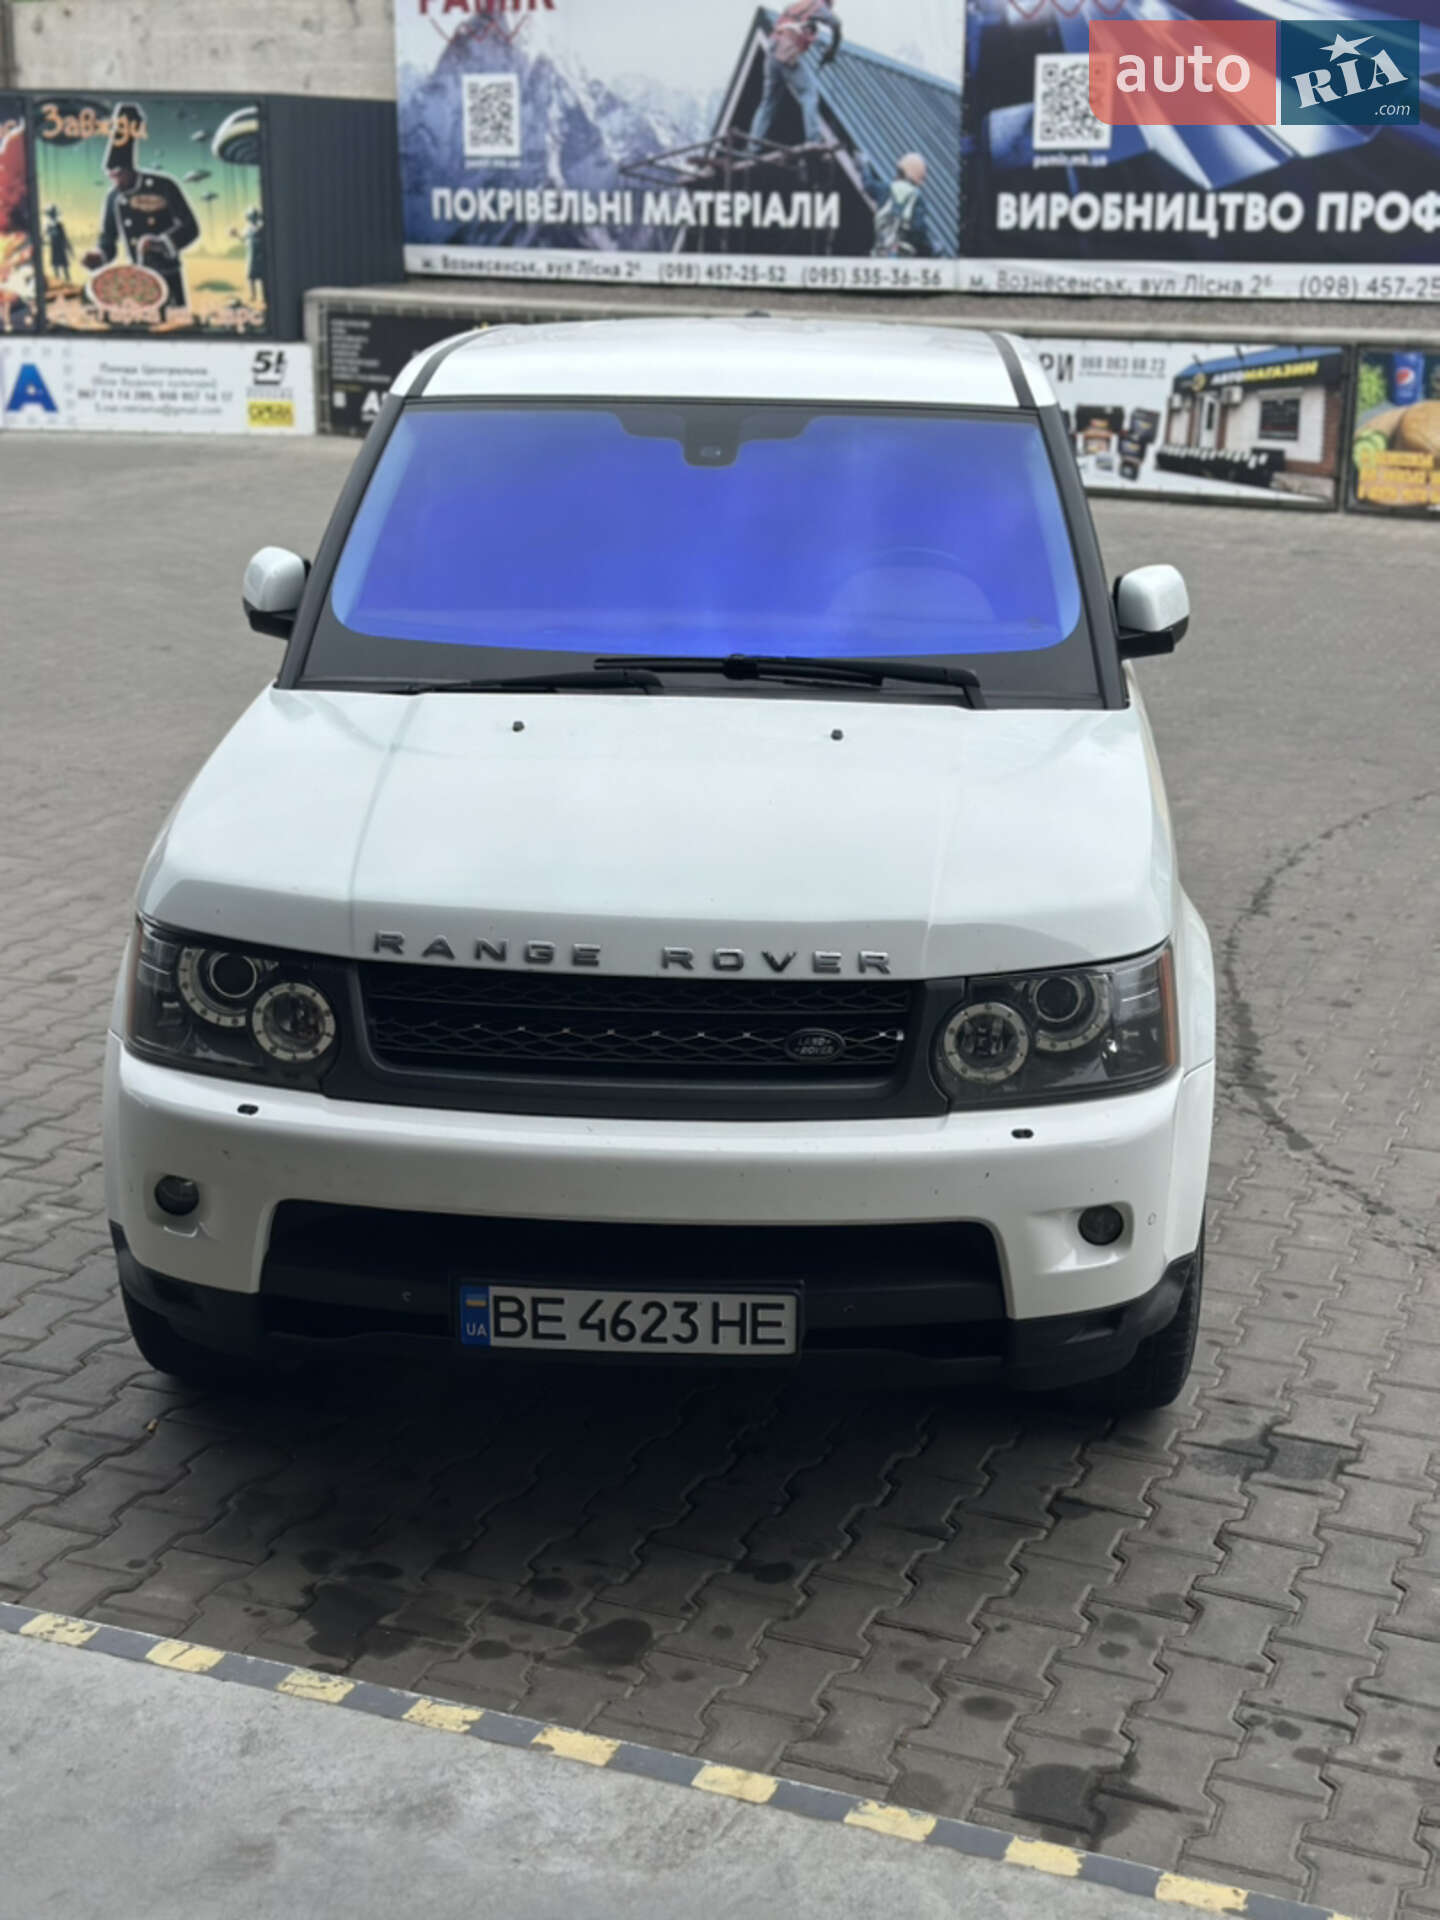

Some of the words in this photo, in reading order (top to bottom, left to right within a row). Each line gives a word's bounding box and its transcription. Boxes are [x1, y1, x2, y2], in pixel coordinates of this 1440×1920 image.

[41, 103, 148, 147] Завжди
[431, 187, 634, 226] ПОКРІВЕЛЬНІ
[642, 190, 840, 230] МАТЕРІАЛИ
[996, 190, 1305, 239] ВИРОБНИЦТВО
[1316, 190, 1440, 234] ПРОФ
[705, 264, 786, 283] 457-25-52
[801, 265, 846, 288] (095)
[852, 267, 941, 286] 535-36-56
[996, 270, 1133, 294] Вознесенськ,
[1183, 274, 1243, 294] Лісна
[1300, 274, 1358, 299] (098)
[372, 929, 601, 968] RANGE
[661, 946, 892, 975] ROVER
[800, 1046, 834, 1055] ROVER
[466, 1322, 488, 1337] UA
[493, 1295, 566, 1341] BE
[579, 1299, 698, 1344] 4623
[711, 1301, 786, 1346] HE
